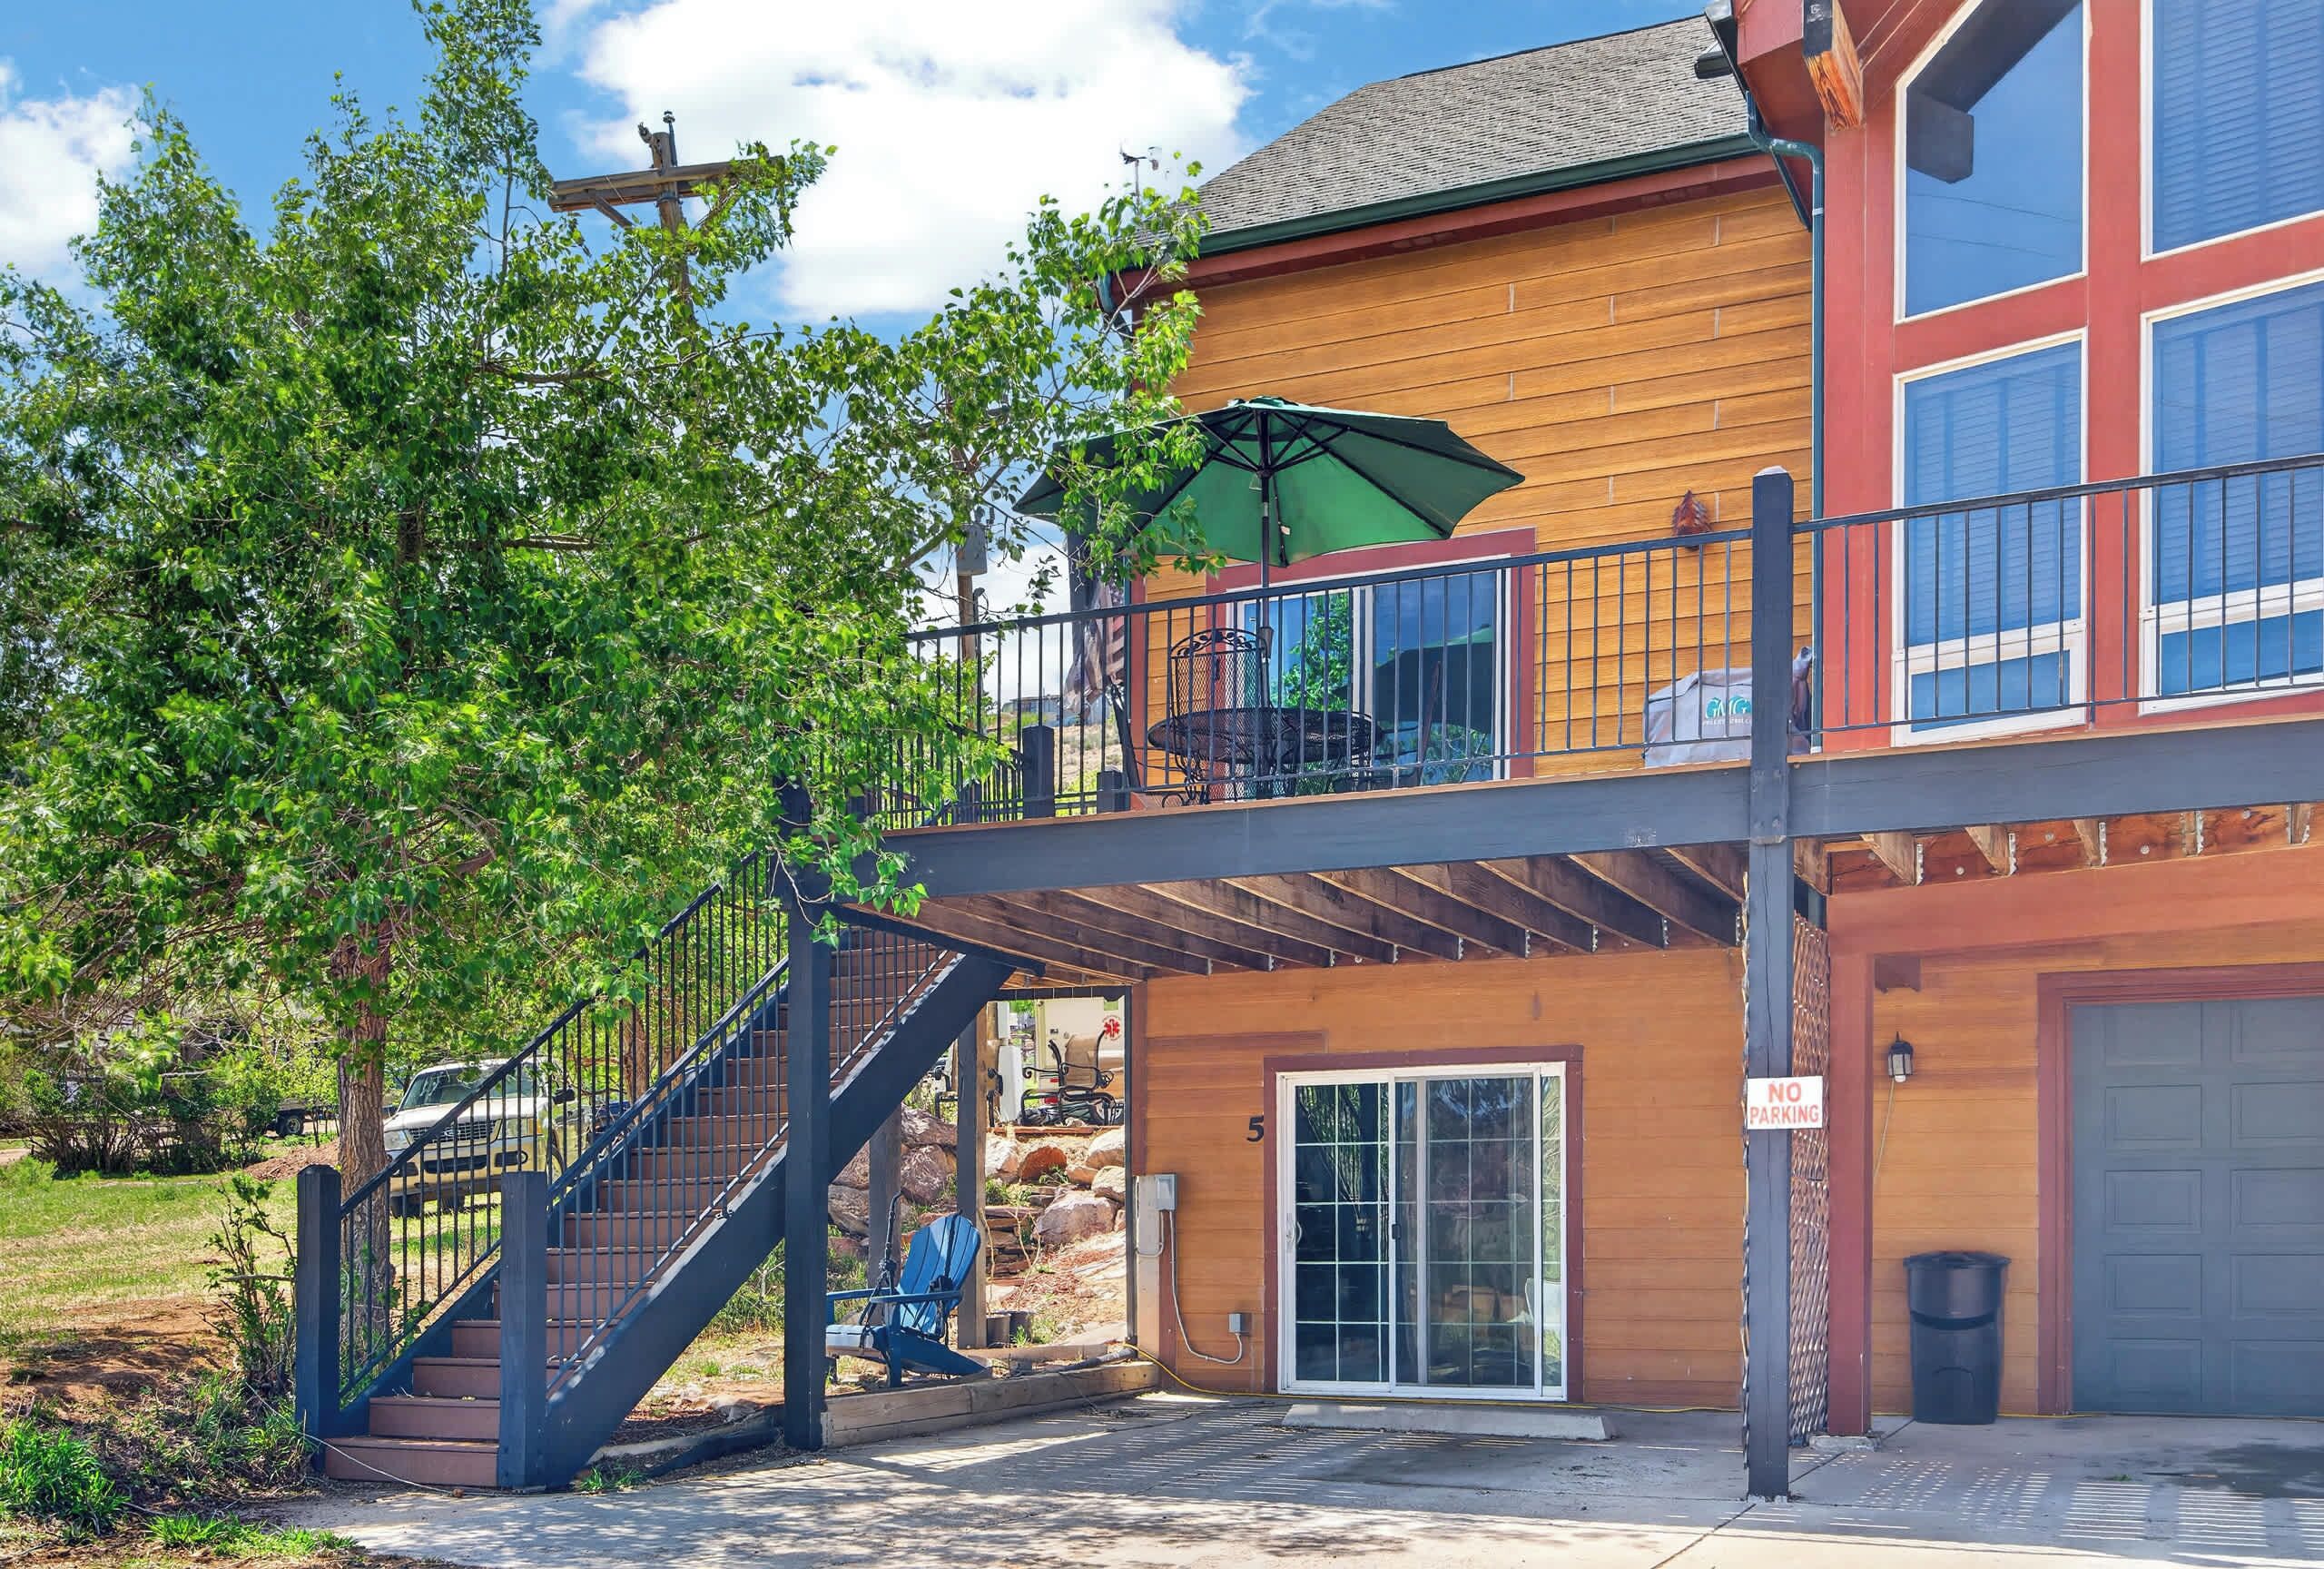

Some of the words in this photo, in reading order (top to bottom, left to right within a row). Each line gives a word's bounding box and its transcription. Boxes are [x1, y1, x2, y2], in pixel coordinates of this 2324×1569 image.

[1768, 1082, 1801, 1103] NO
[1749, 1104, 1819, 1125] PARKING
[1246, 1115, 1264, 1142] 5
